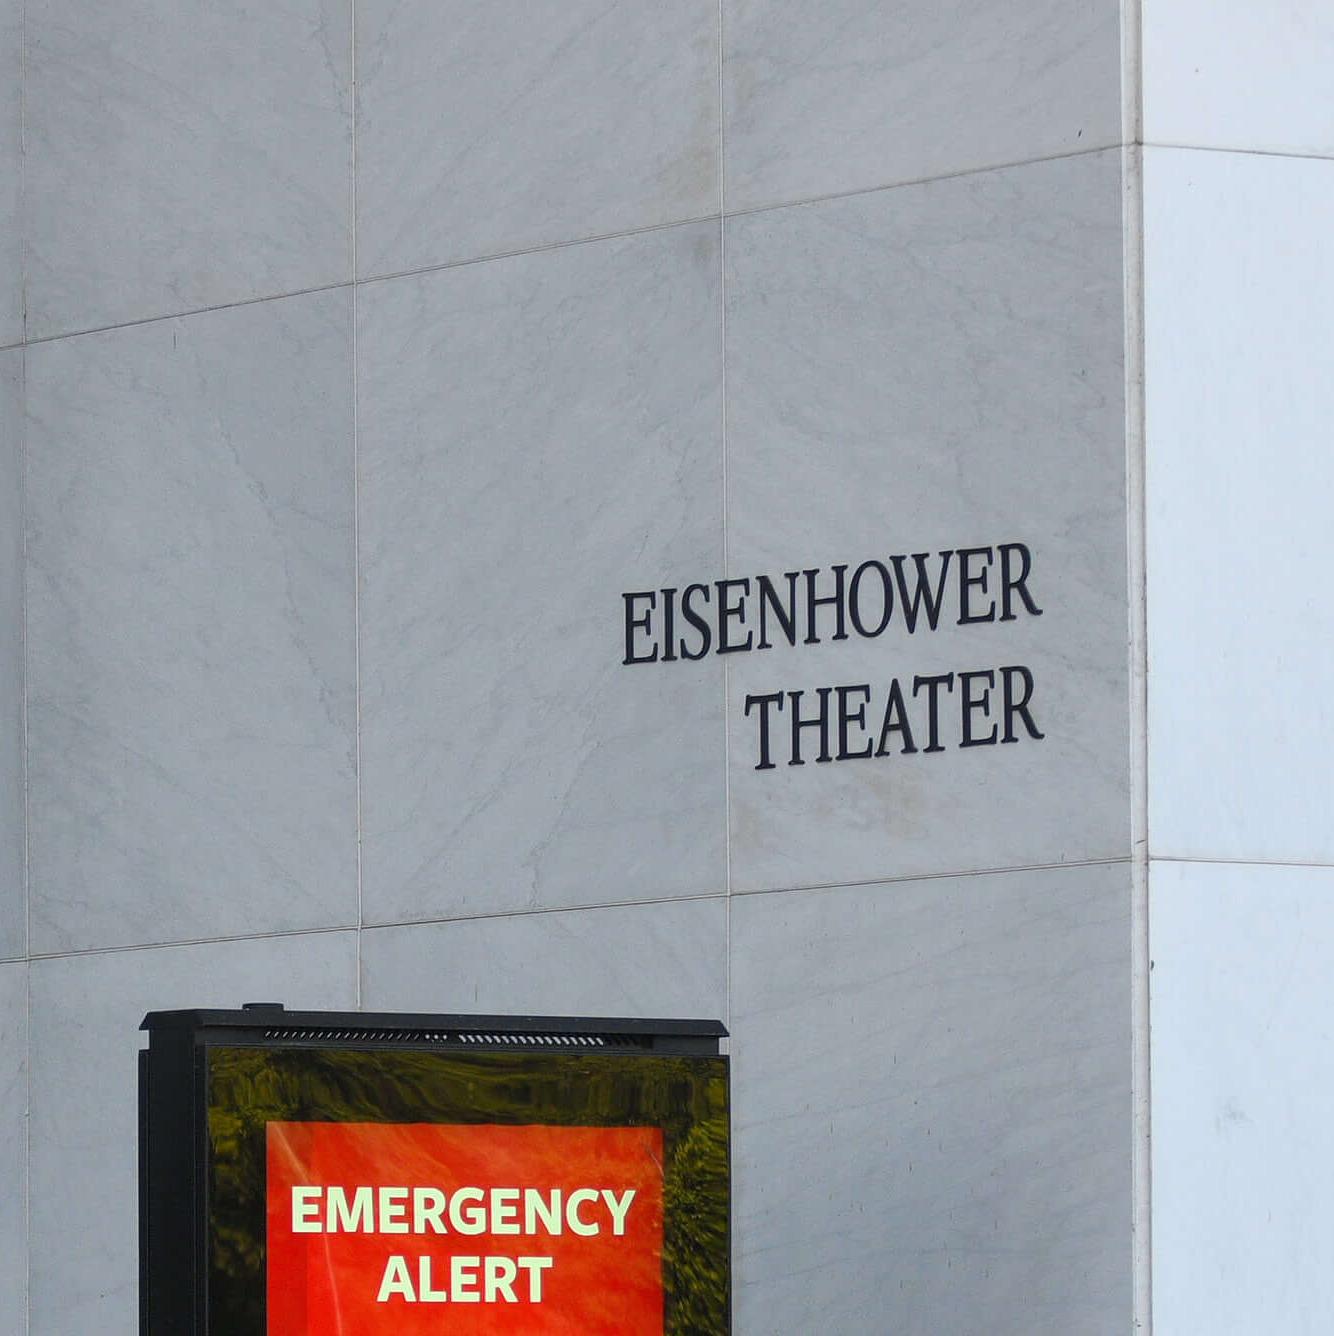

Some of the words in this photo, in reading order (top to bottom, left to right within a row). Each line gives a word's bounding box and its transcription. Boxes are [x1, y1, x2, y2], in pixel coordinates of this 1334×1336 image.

[621, 542, 1044, 666] EISENHOWER
[744, 665, 1046, 771] THEATER
[291, 1185, 636, 1237] EMERGENCY
[376, 1255, 553, 1303] ALERT
